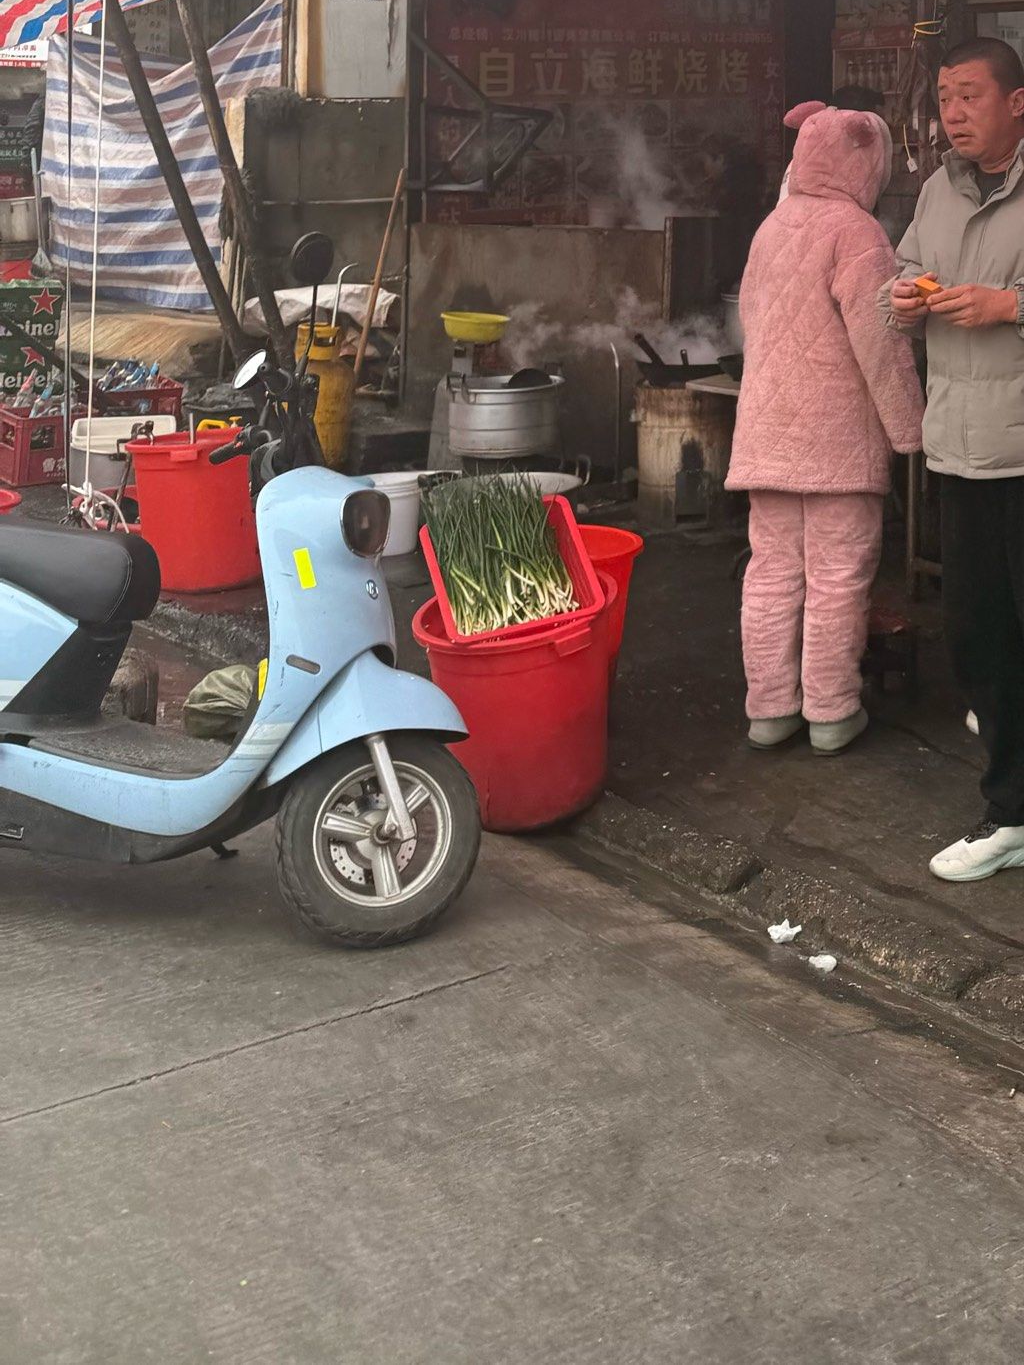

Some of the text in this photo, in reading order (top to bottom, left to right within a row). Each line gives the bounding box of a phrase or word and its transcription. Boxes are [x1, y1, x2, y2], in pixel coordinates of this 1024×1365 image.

[479, 47, 749, 97] 自立海鲜烧烤
